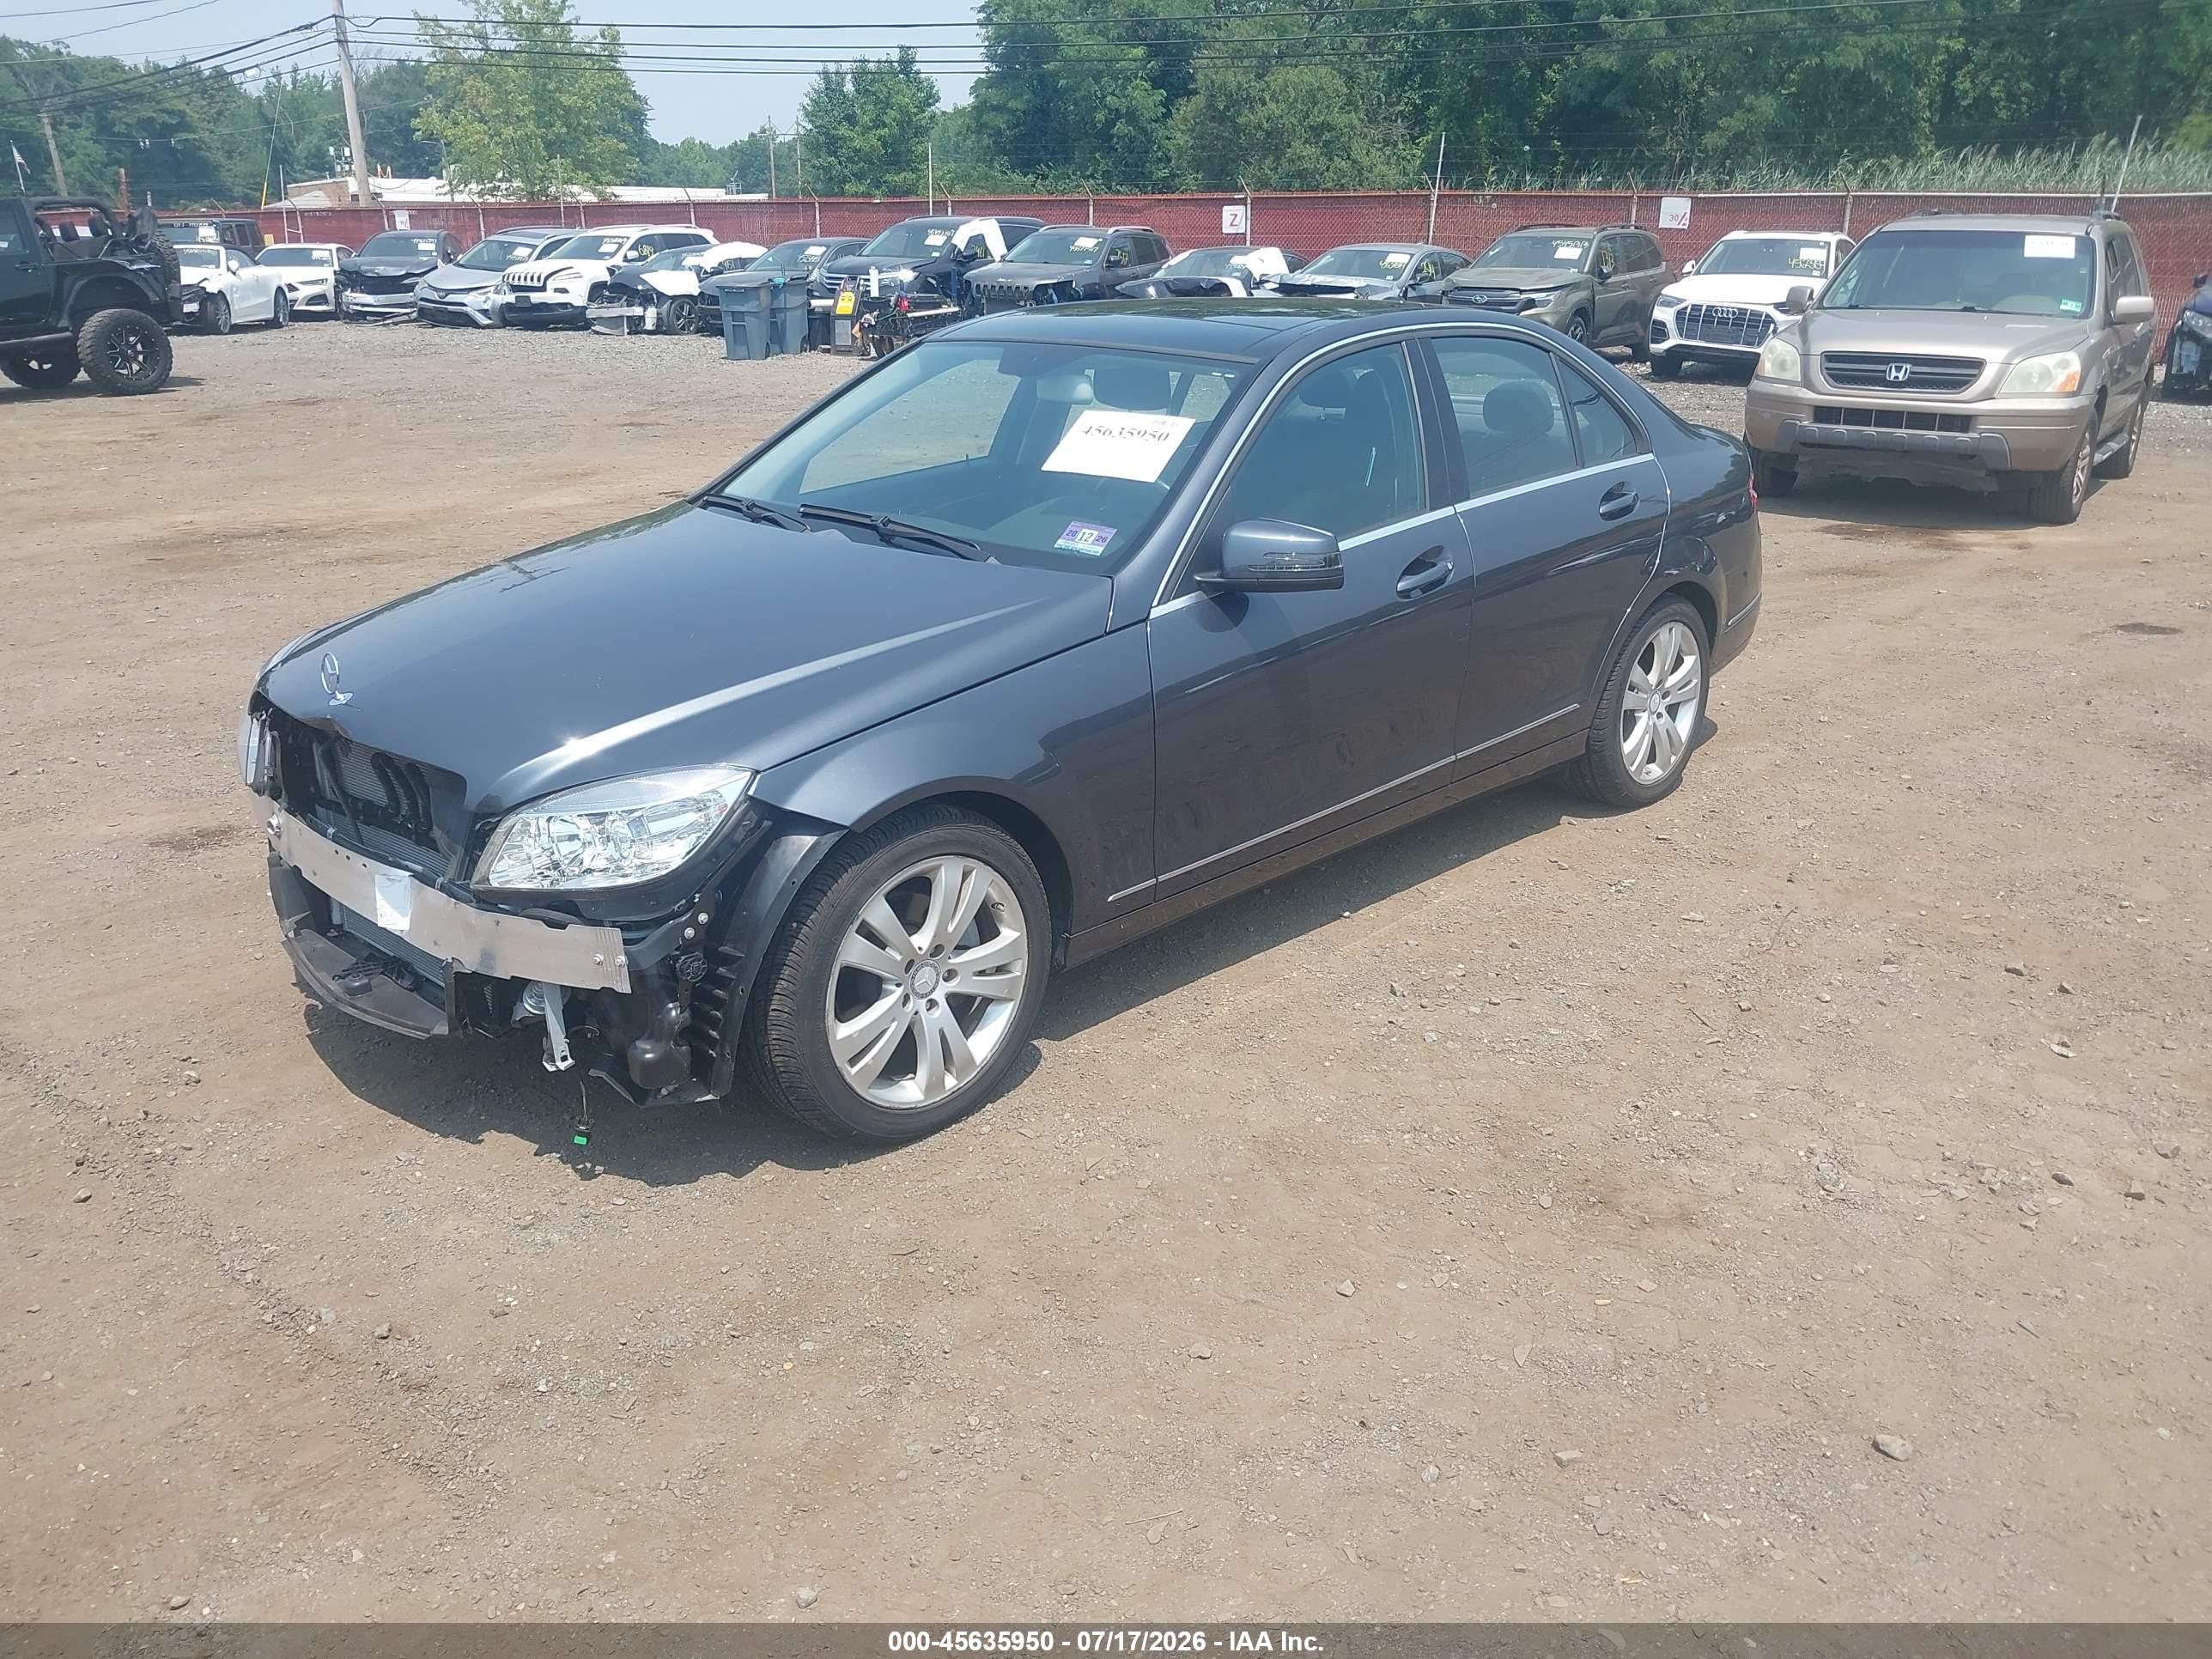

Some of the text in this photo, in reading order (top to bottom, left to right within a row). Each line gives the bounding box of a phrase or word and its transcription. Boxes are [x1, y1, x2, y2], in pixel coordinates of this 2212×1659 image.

[1229, 214, 1238, 227] Z
[1081, 425, 1170, 442] 45635950
[1066, 529, 1109, 544] 20 12 26
